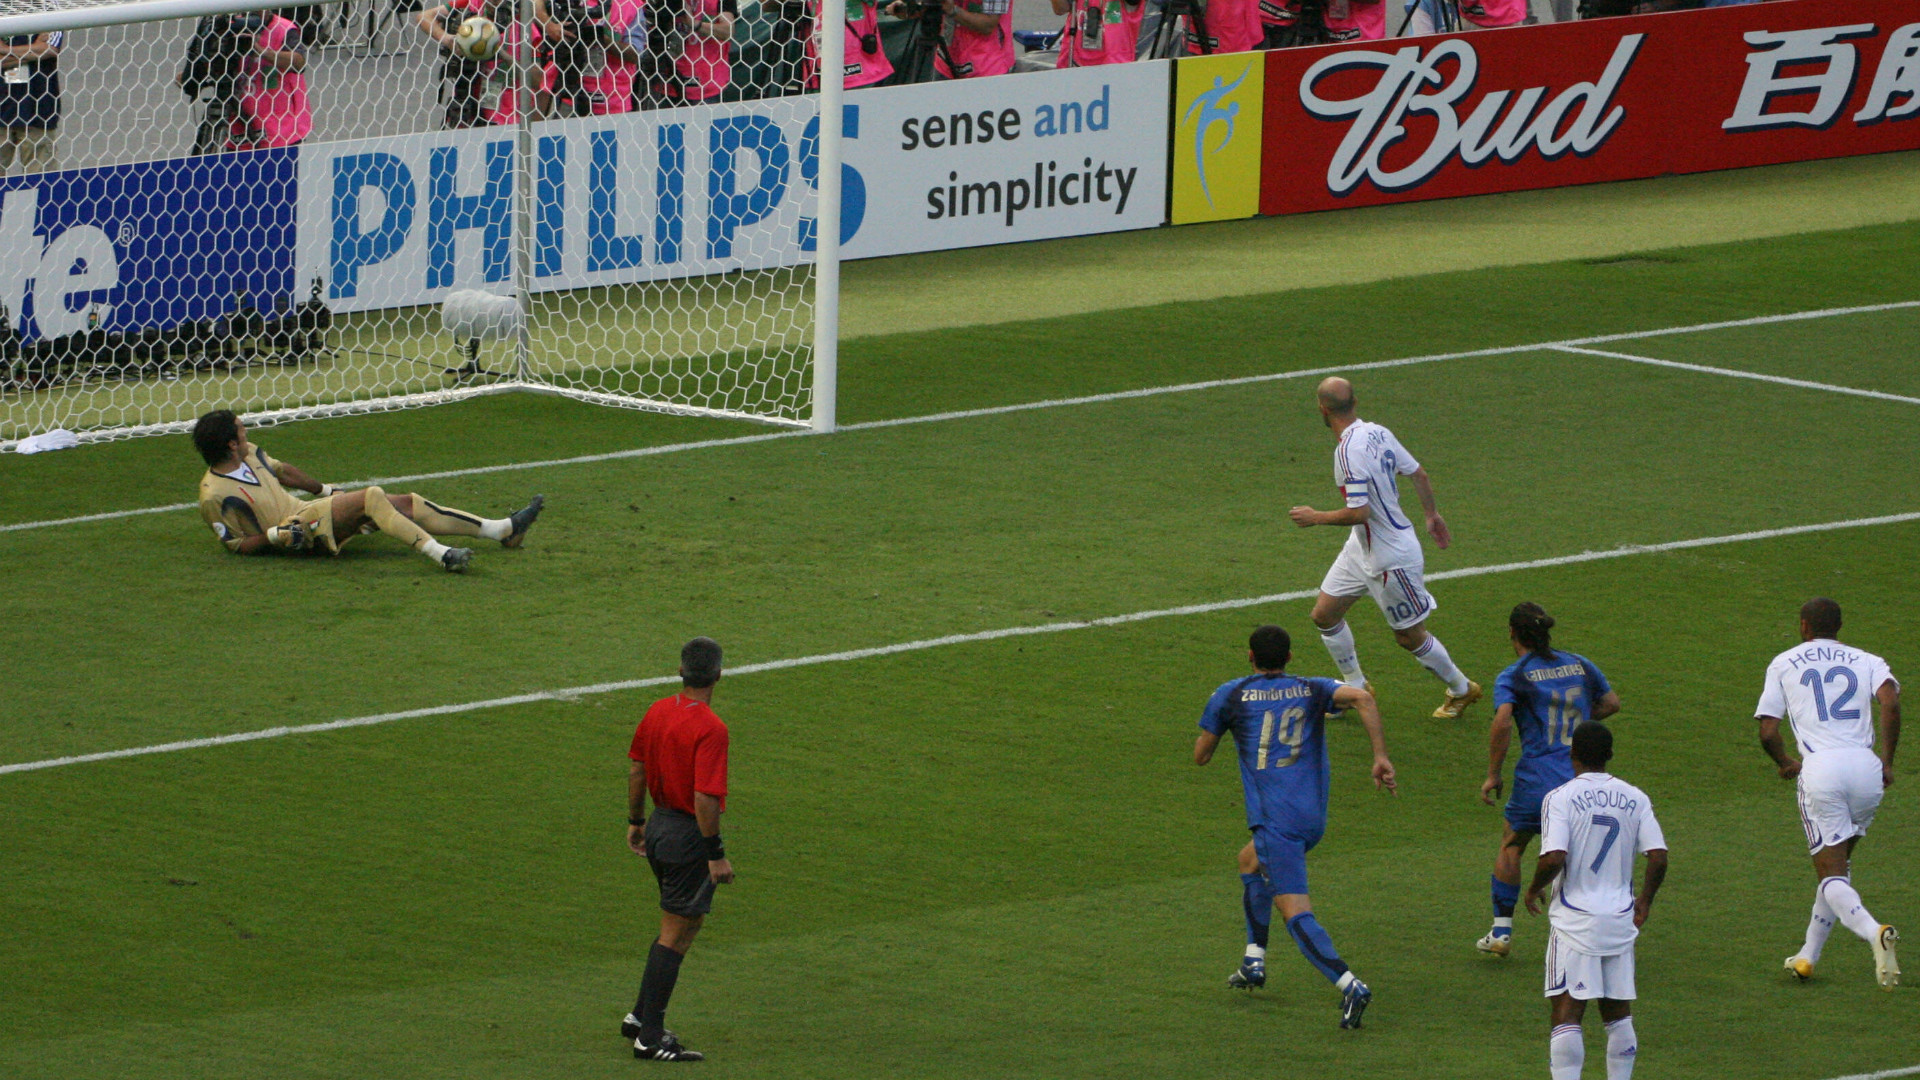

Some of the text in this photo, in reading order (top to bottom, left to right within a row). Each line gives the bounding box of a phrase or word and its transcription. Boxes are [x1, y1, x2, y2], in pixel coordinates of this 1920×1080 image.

[901, 84, 1110, 151] sense and
[1300, 39, 1647, 193] Bud
[330, 104, 867, 300] PHILIPS
[926, 156, 1138, 227] simplicity
[1387, 601, 1412, 622] 10
[1788, 646, 1860, 670] HENRY
[1241, 685, 1312, 702] zambrotta
[1547, 685, 1584, 747] 16
[1800, 665, 1860, 722] 12
[1256, 705, 1306, 770] 19
[1571, 789, 1637, 817] MALOUDA
[1590, 814, 1620, 875] 7
